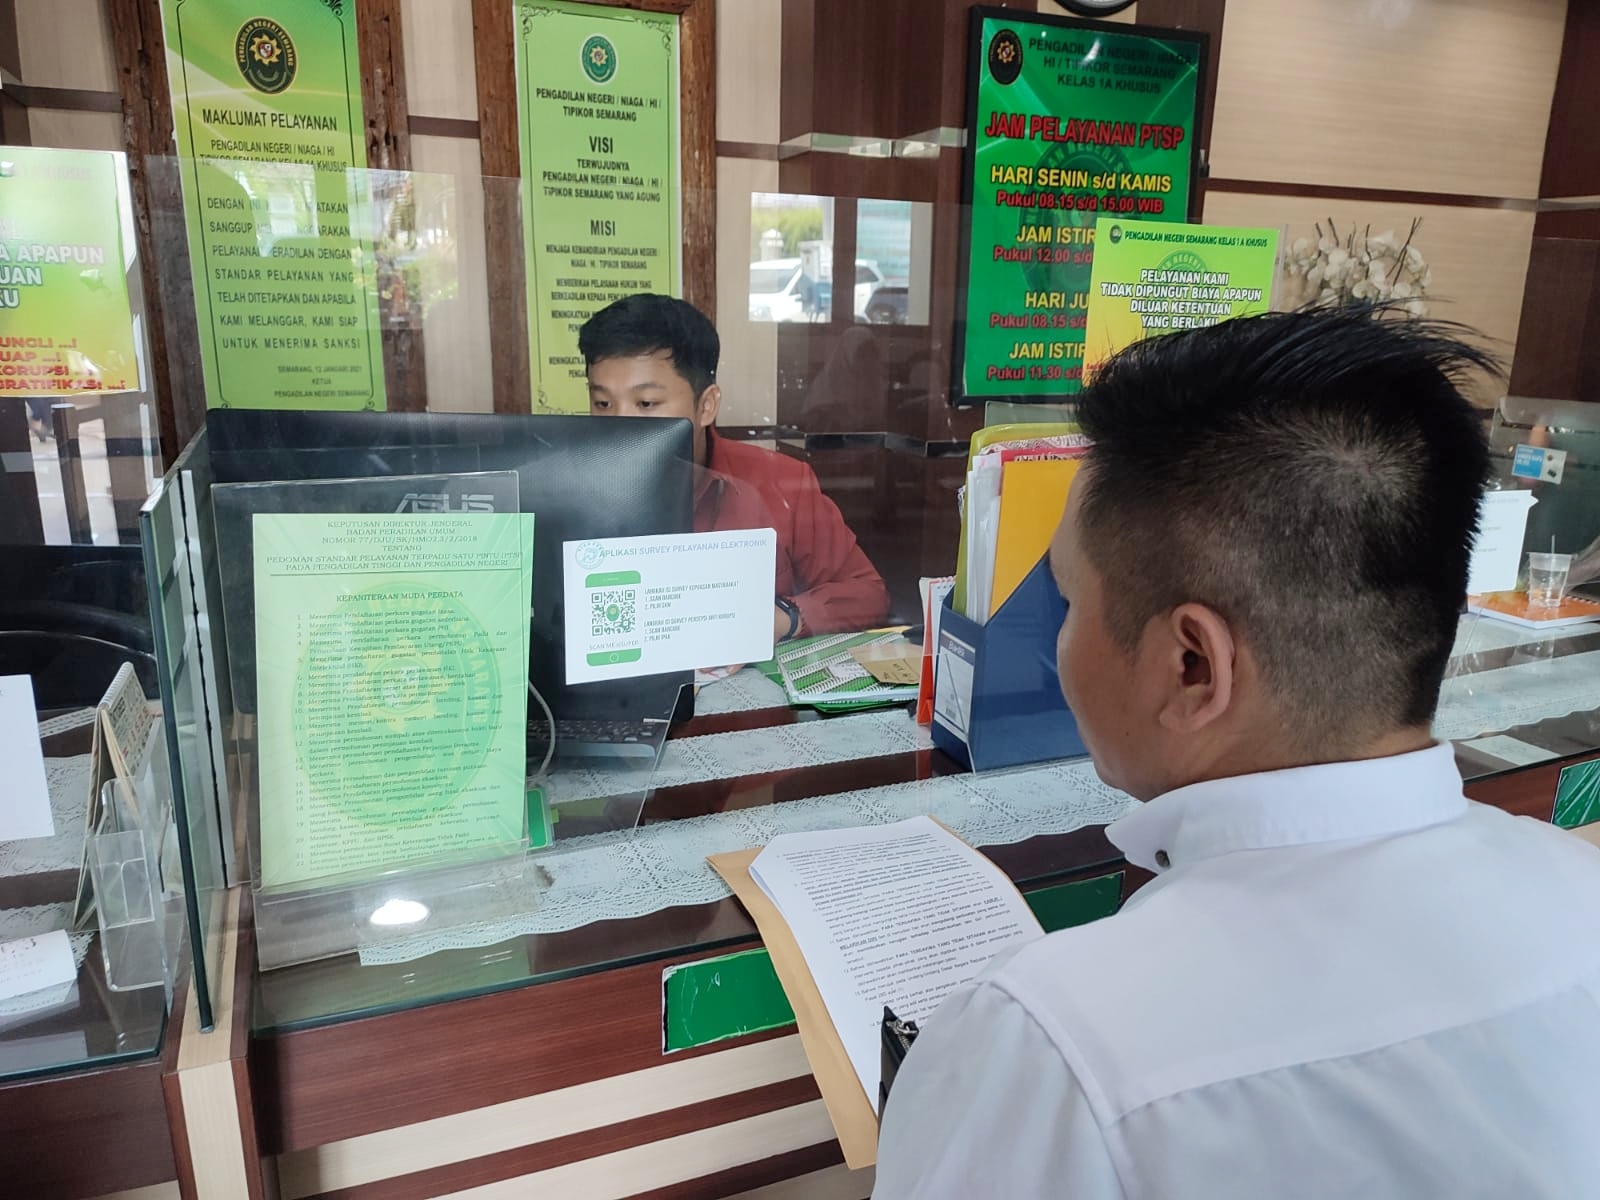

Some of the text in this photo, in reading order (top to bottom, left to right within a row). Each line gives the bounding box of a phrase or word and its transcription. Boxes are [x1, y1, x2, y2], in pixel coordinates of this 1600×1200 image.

[1028, 38, 1104, 57] PENGADILN
[1057, 74, 1096, 88] KELAS
[1114, 80, 1161, 94] KHUSUS
[536, 88, 658, 109] PENGADILAN NEGERI NIAGA HI
[202, 108, 338, 132] MAKLUMAT PELAYANAN
[563, 106, 637, 122] TIPIKOR SEMARANG
[986, 112, 1185, 150] JAM PELAYANAN PTSP
[210, 139, 261, 153] PENGADILAN
[263, 142, 293, 154] NEGERI
[297, 144, 321, 156] NIAGA
[589, 136, 614, 154] VISI
[576, 158, 630, 172] TERWUJUDNYA
[542, 171, 589, 184] PENGADILAN
[590, 174, 617, 186] NEGERI
[622, 176, 644, 187] NIAGA
[990, 165, 1172, 193] HARI SENIN s/d KAMIS
[543, 186, 660, 202] TIPIKOR SEMARANG YANG AGUNG
[996, 190, 1164, 214] Pukul 08.15 s/d 15.00 WIB
[207, 198, 244, 210] DENGAN
[209, 221, 253, 234] SANGGUP
[590, 220, 616, 236] MISI
[1016, 224, 1052, 244] JAM
[1124, 230, 1163, 241] PENGADILAN
[1164, 233, 1185, 243] NEGERI
[1185, 234, 1217, 245] SEMARANG
[1218, 236, 1236, 246] KELAS
[1246, 238, 1268, 248] KHUSUS
[16, 243, 105, 264] APAPUN
[267, 247, 315, 258] ERADILAN
[318, 248, 352, 260] DENGAN
[993, 246, 1032, 262] Pukul
[1036, 246, 1070, 263] 12.00
[215, 268, 354, 282] STANDAR PELAYANAN YANG
[1140, 268, 1230, 286] PELAYANAN KAMI
[217, 292, 356, 305] TELAH DITETAPKAN DAN APABILA
[1024, 290, 1065, 309] HARI
[1100, 282, 1262, 301] TIDAK DIPUNGUT BIAYA APAPUN
[1130, 300, 1232, 315] DILUAR KETENTUAN
[220, 315, 358, 328] KAMI MELANGGAR, KAMI SIAP
[989, 313, 1029, 329] Pukul
[1032, 314, 1066, 329] 08.15
[1141, 315, 1170, 328] YANG
[222, 338, 360, 350] UNTUK MENERIMA SANKSI
[1009, 342, 1045, 360] JAM
[987, 364, 1026, 380] Pukul
[1029, 366, 1062, 380] 11.30
[395, 493, 495, 513] ASUS
[639, 546, 670, 555] SURVEY
[672, 542, 720, 553] PELAYANAN
[266, 556, 313, 564] PEDOMAN
[360, 554, 408, 562] PELAYANAN
[424, 560, 476, 568] PENGADILAN
[336, 591, 464, 602] KEPANITERAAN MUDA PERDATA
